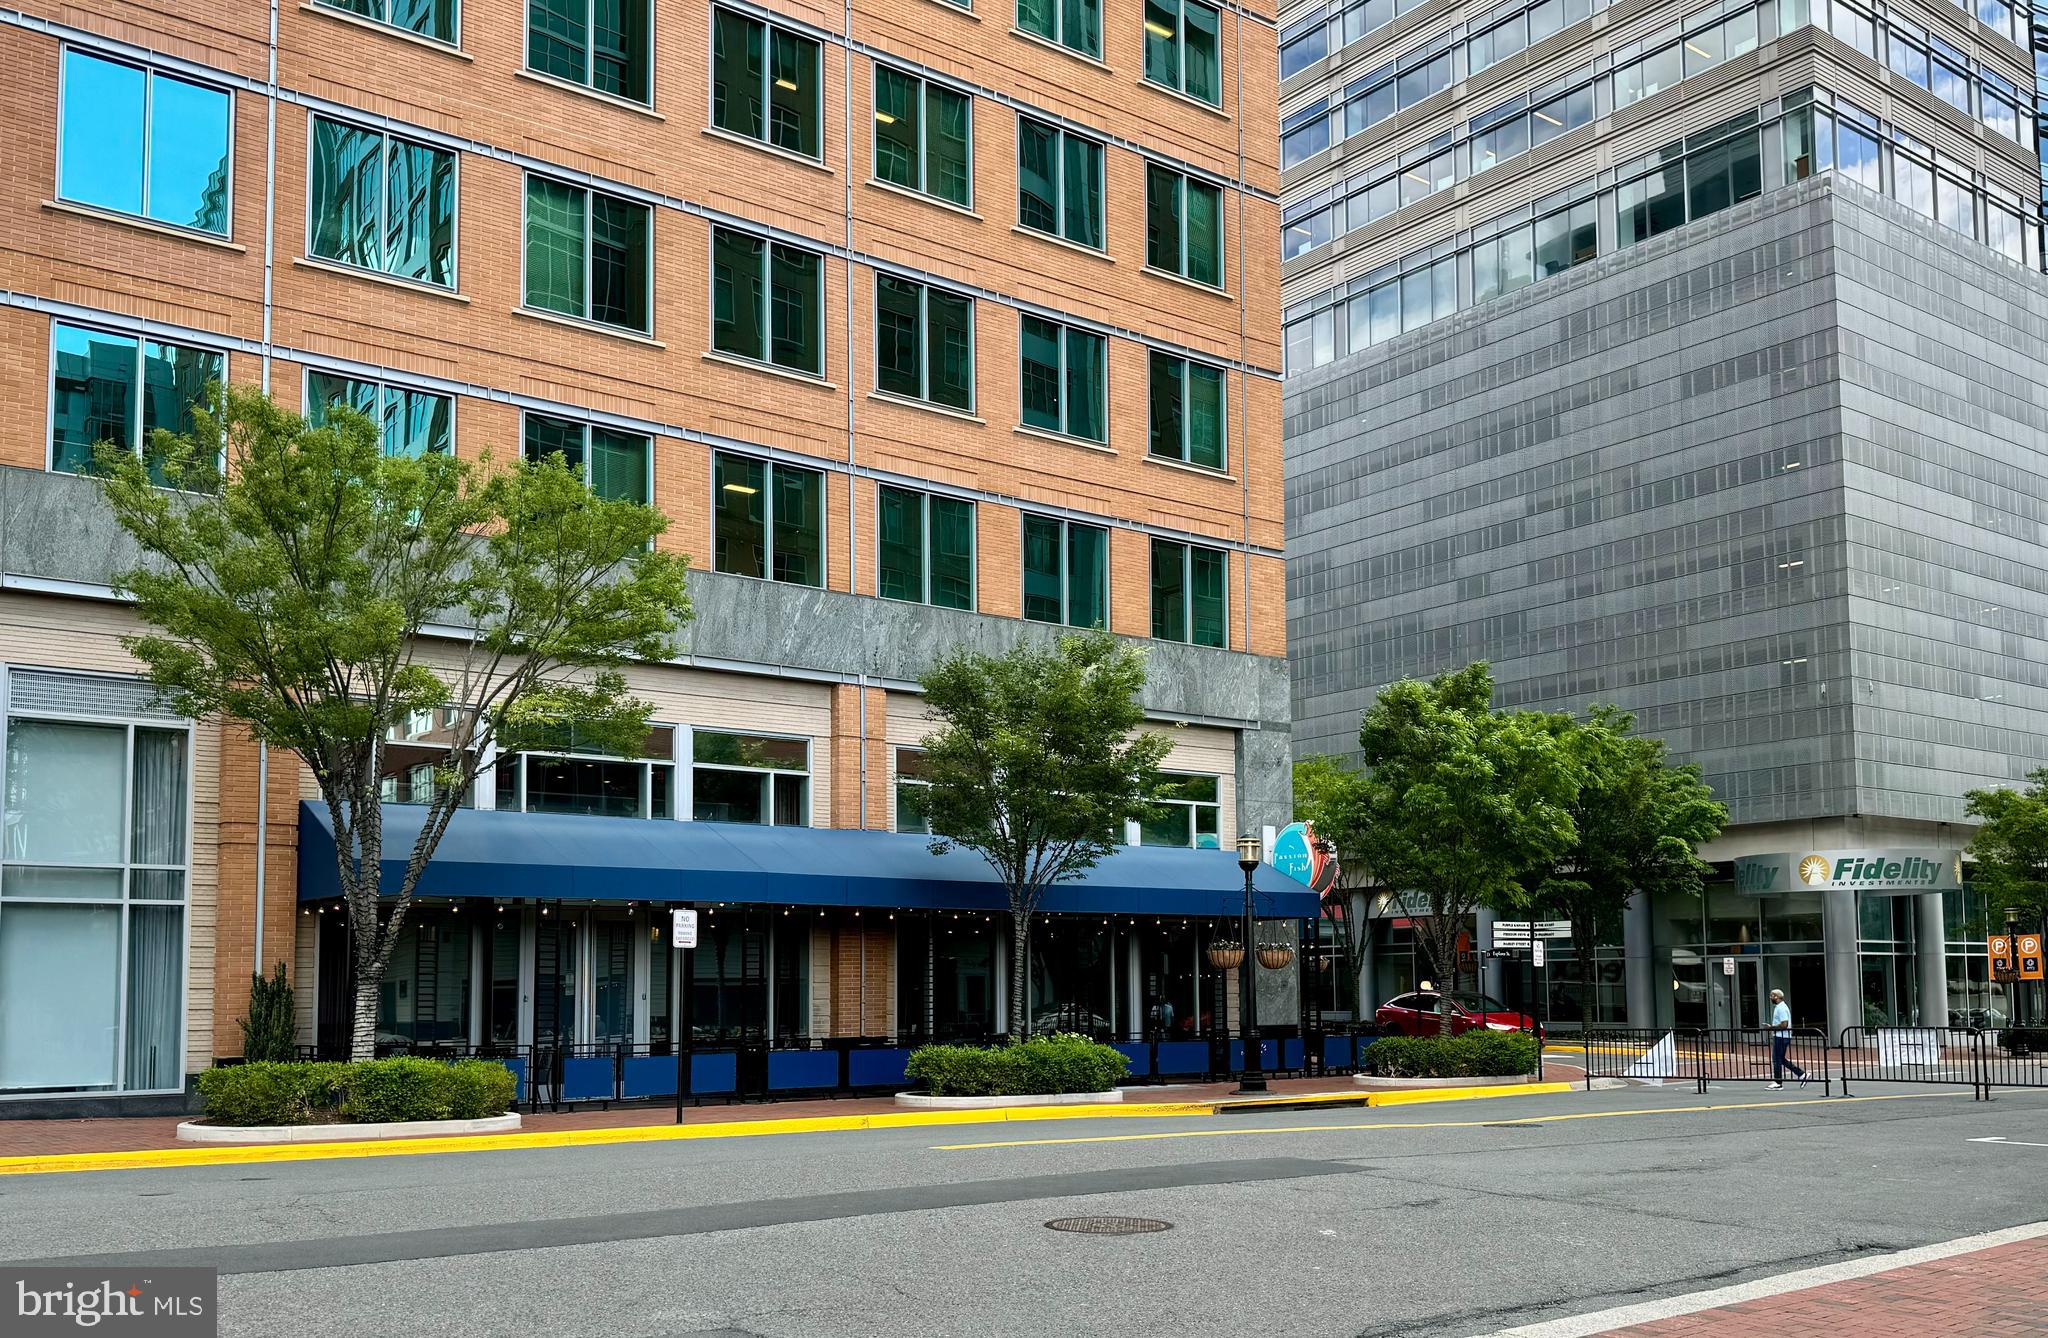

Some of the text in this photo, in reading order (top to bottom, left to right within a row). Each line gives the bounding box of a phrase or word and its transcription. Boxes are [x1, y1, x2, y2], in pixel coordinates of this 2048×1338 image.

[1274, 853, 1307, 864] Passion
[1289, 862, 1306, 876] Fish
[1832, 857, 1942, 885] Fidelity
[1832, 879, 1927, 887] INVESTMENTS
[681, 915, 690, 923] NO
[1995, 941, 2004, 952] P
[2025, 940, 2034, 951] P
